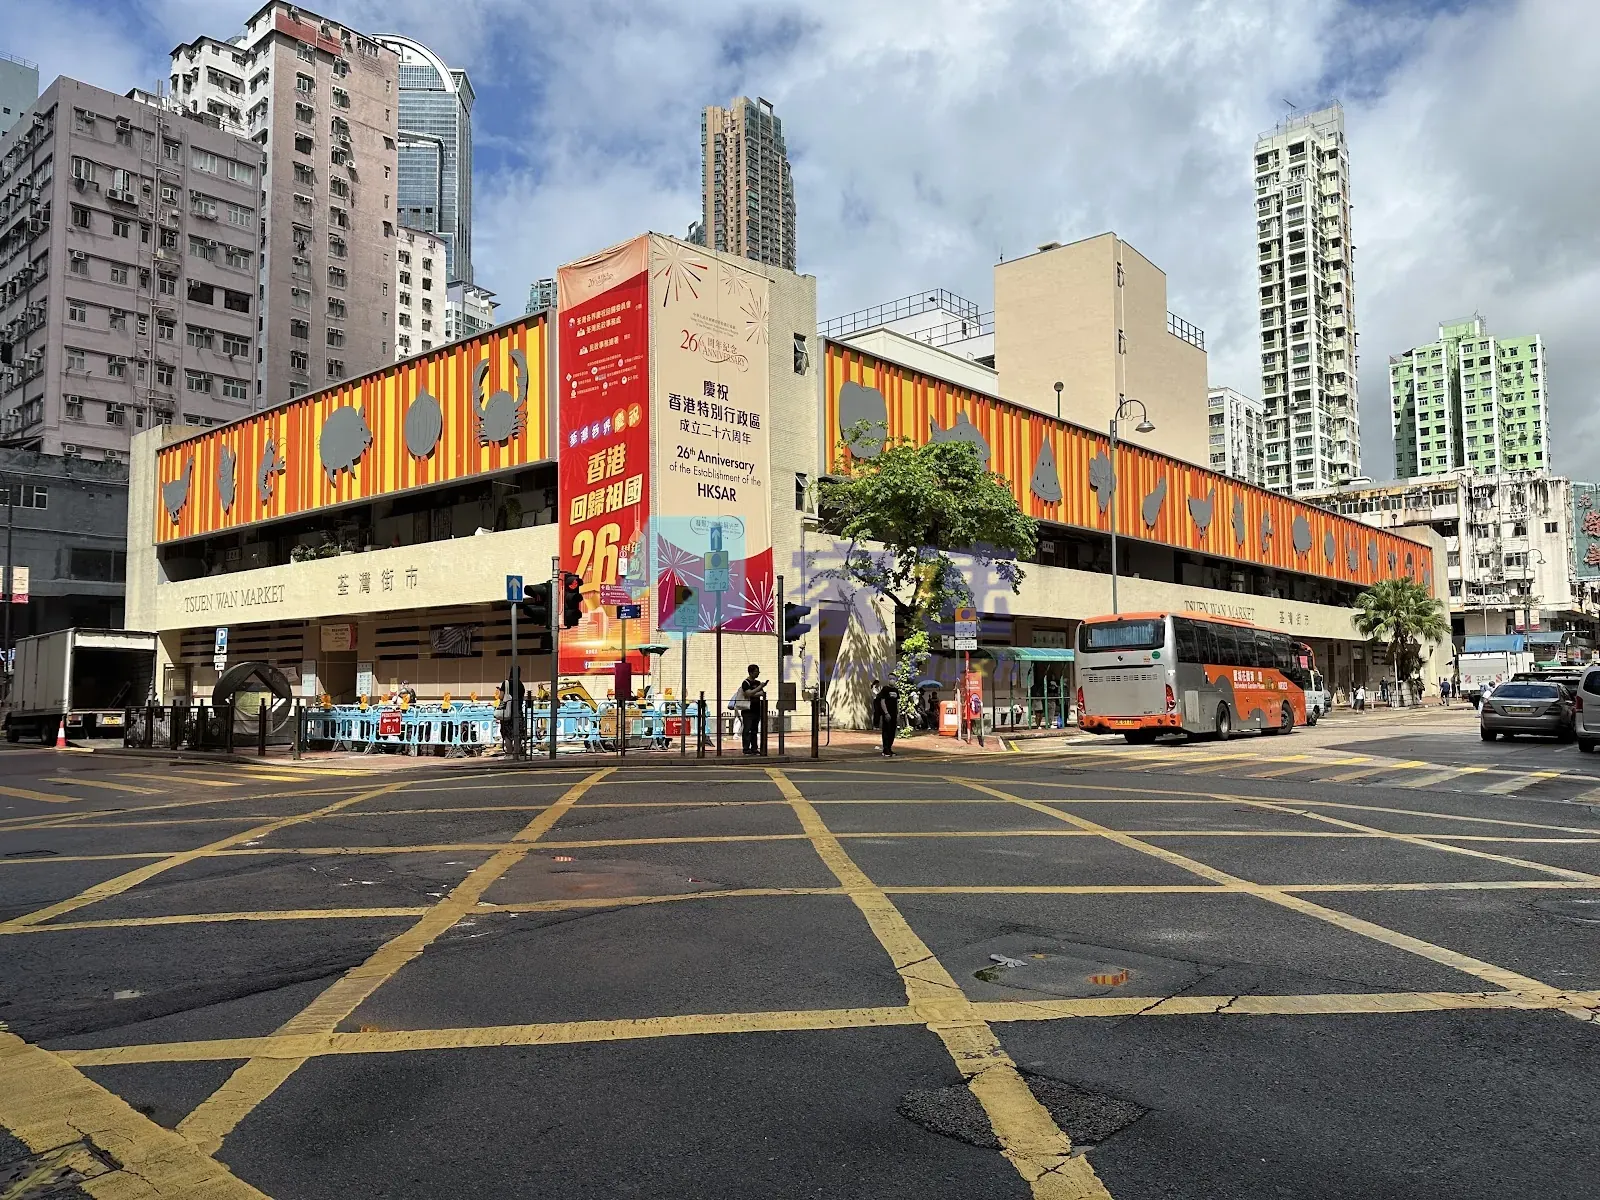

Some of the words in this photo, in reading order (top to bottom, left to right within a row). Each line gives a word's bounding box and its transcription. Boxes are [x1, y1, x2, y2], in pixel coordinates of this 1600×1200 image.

[680, 329, 698, 352] 26
[702, 346, 745, 367] ANNIVERSARY
[703, 380, 729, 402] 慶祝
[668, 392, 761, 430] 香港特別行政區
[679, 418, 752, 445] 成立二十六周年
[587, 442, 627, 485] 香港
[676, 445, 696, 460] 26th
[697, 449, 755, 475] Anniversary
[669, 461, 678, 472] of
[679, 462, 691, 475] the
[693, 465, 740, 483] Establishment
[742, 474, 750, 485] of
[751, 475, 761, 486] the
[569, 473, 643, 526] 回歸祖國
[697, 482, 737, 502] HKSAR
[572, 522, 621, 594] 26
[336, 565, 419, 596] 荃灣街市
[719, 581, 727, 589] 12
[184, 593, 213, 613] TSUEN
[216, 590, 238, 609] WAN
[240, 584, 286, 607] MARKET
[680, 615, 695, 624] 全日
[217, 630, 226, 645] P
